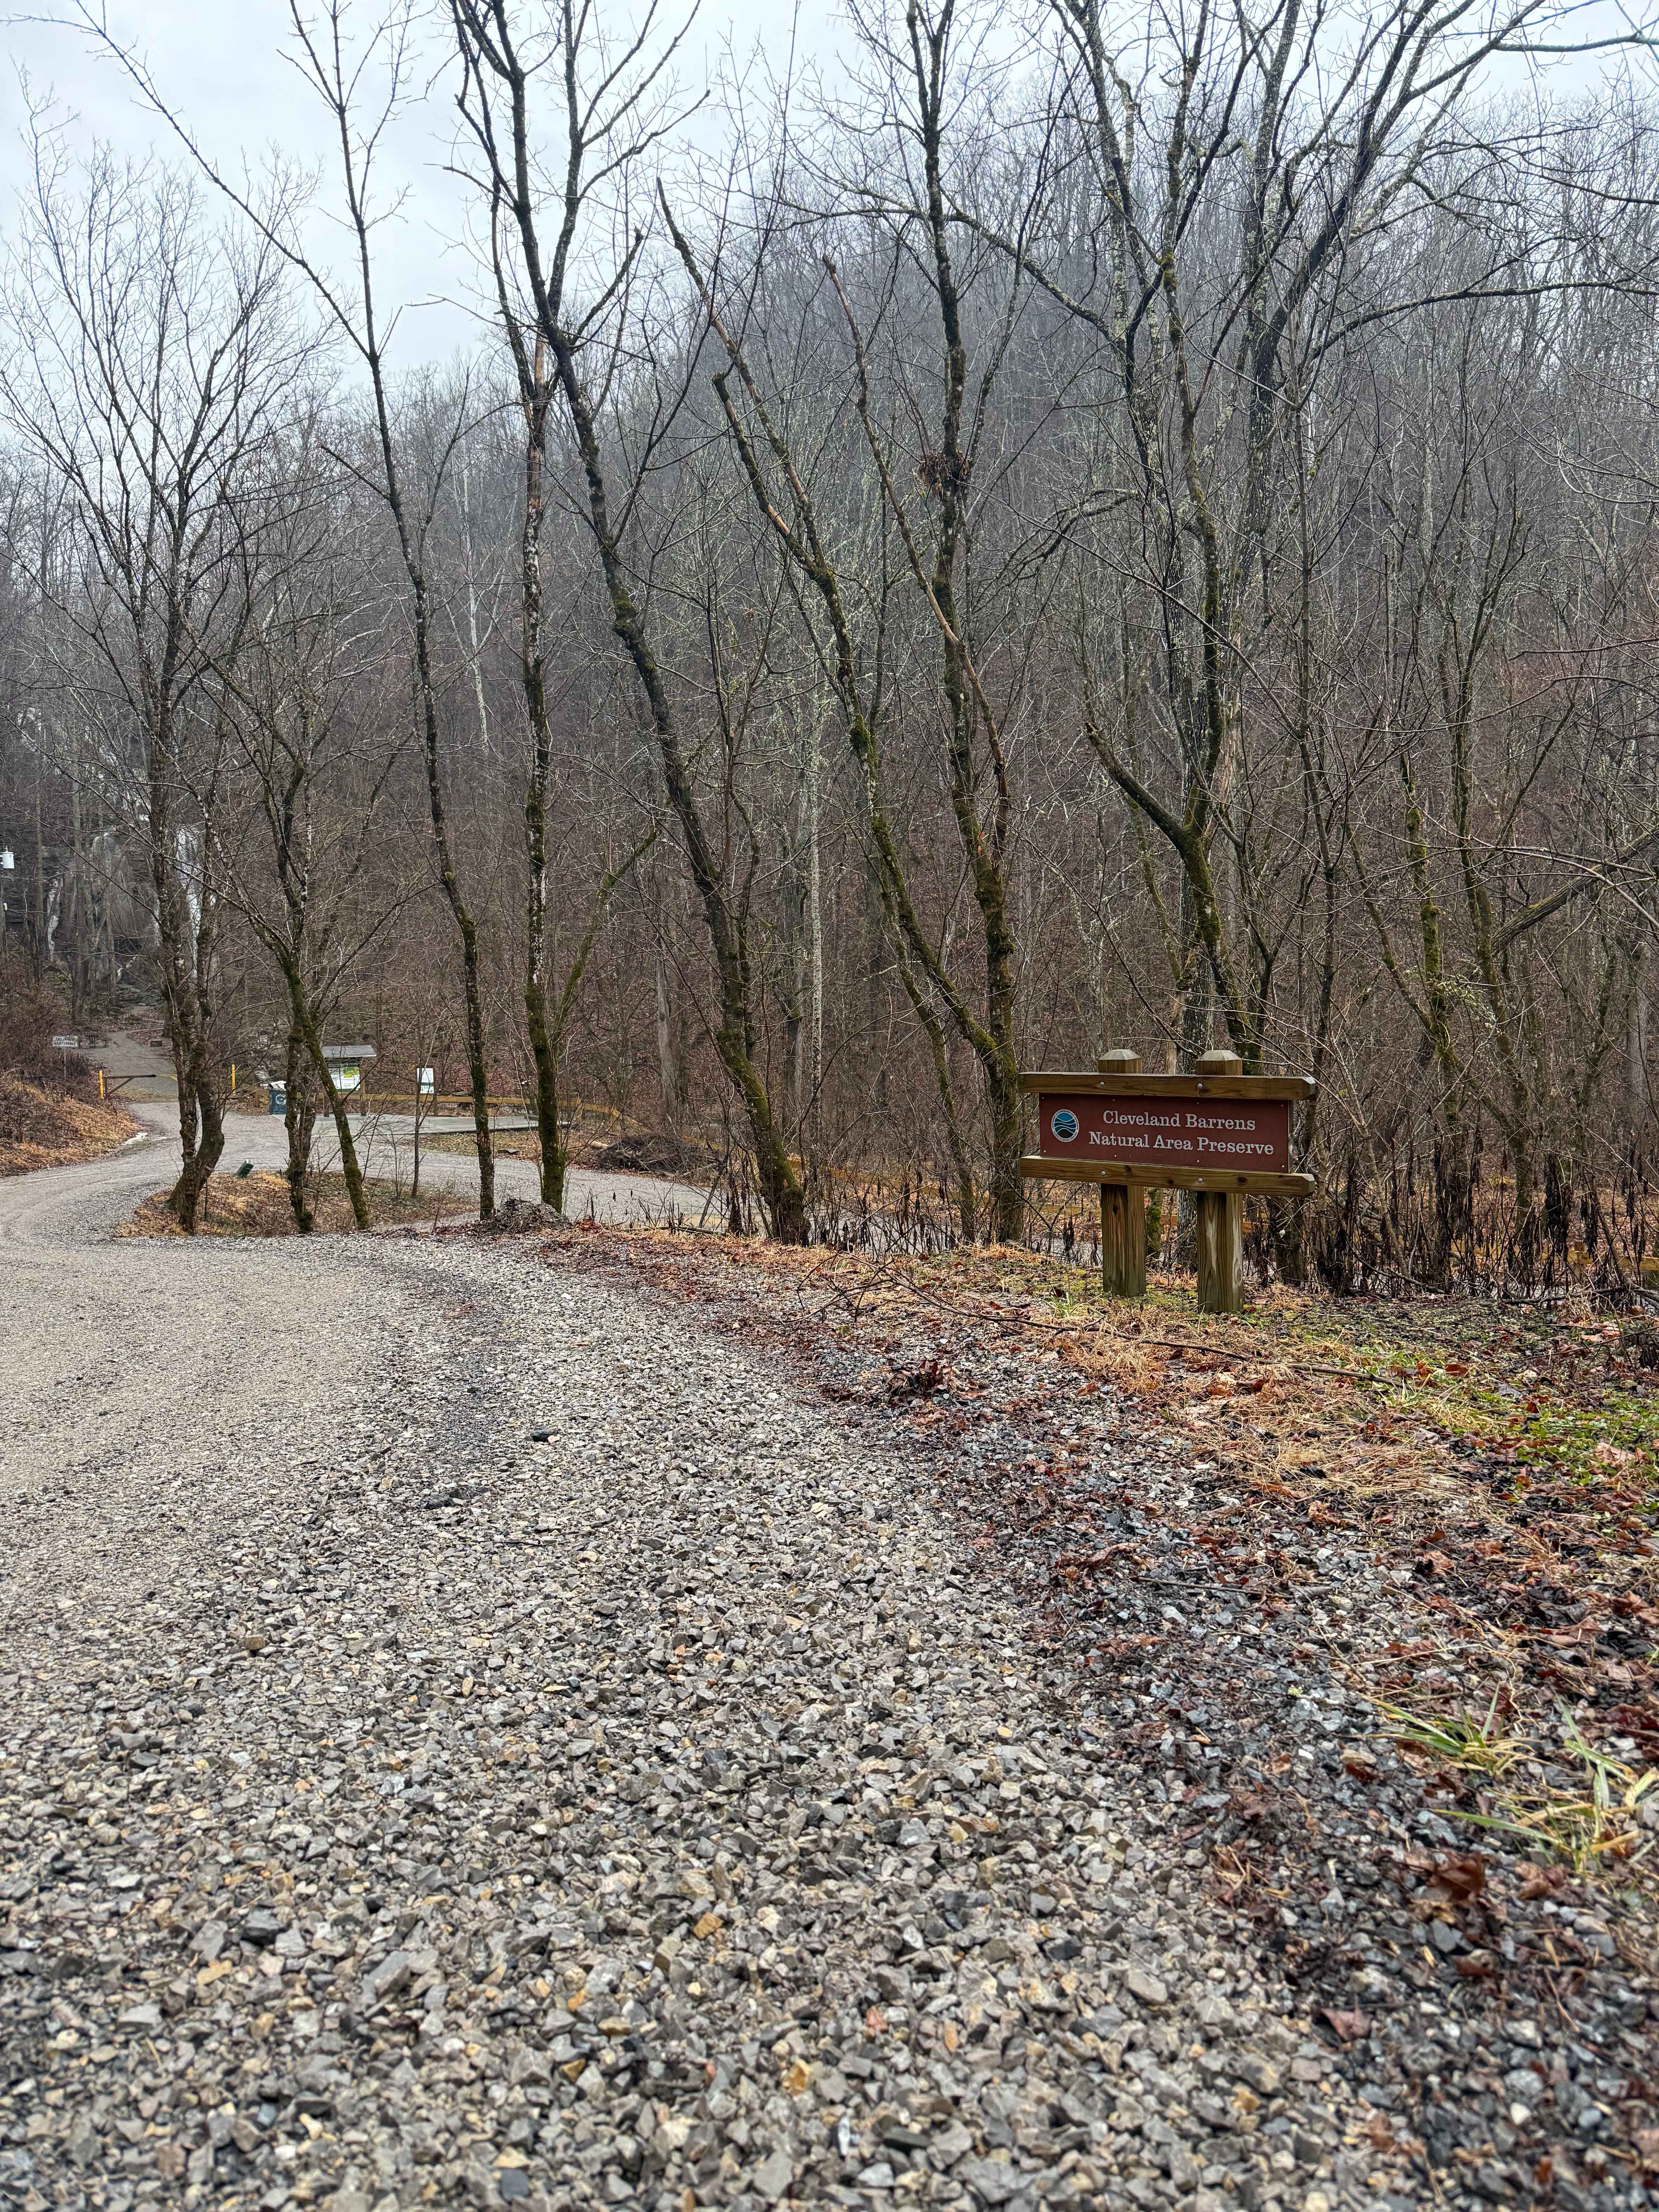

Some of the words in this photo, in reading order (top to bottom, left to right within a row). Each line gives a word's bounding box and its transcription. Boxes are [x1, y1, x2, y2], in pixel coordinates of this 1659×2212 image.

[1103, 1110, 1181, 1127] Cleveland
[1185, 1114, 1256, 1130] Barrens
[1089, 1131, 1149, 1147] Natural
[1153, 1135, 1193, 1150] Area
[1197, 1137, 1274, 1155] Preserve
